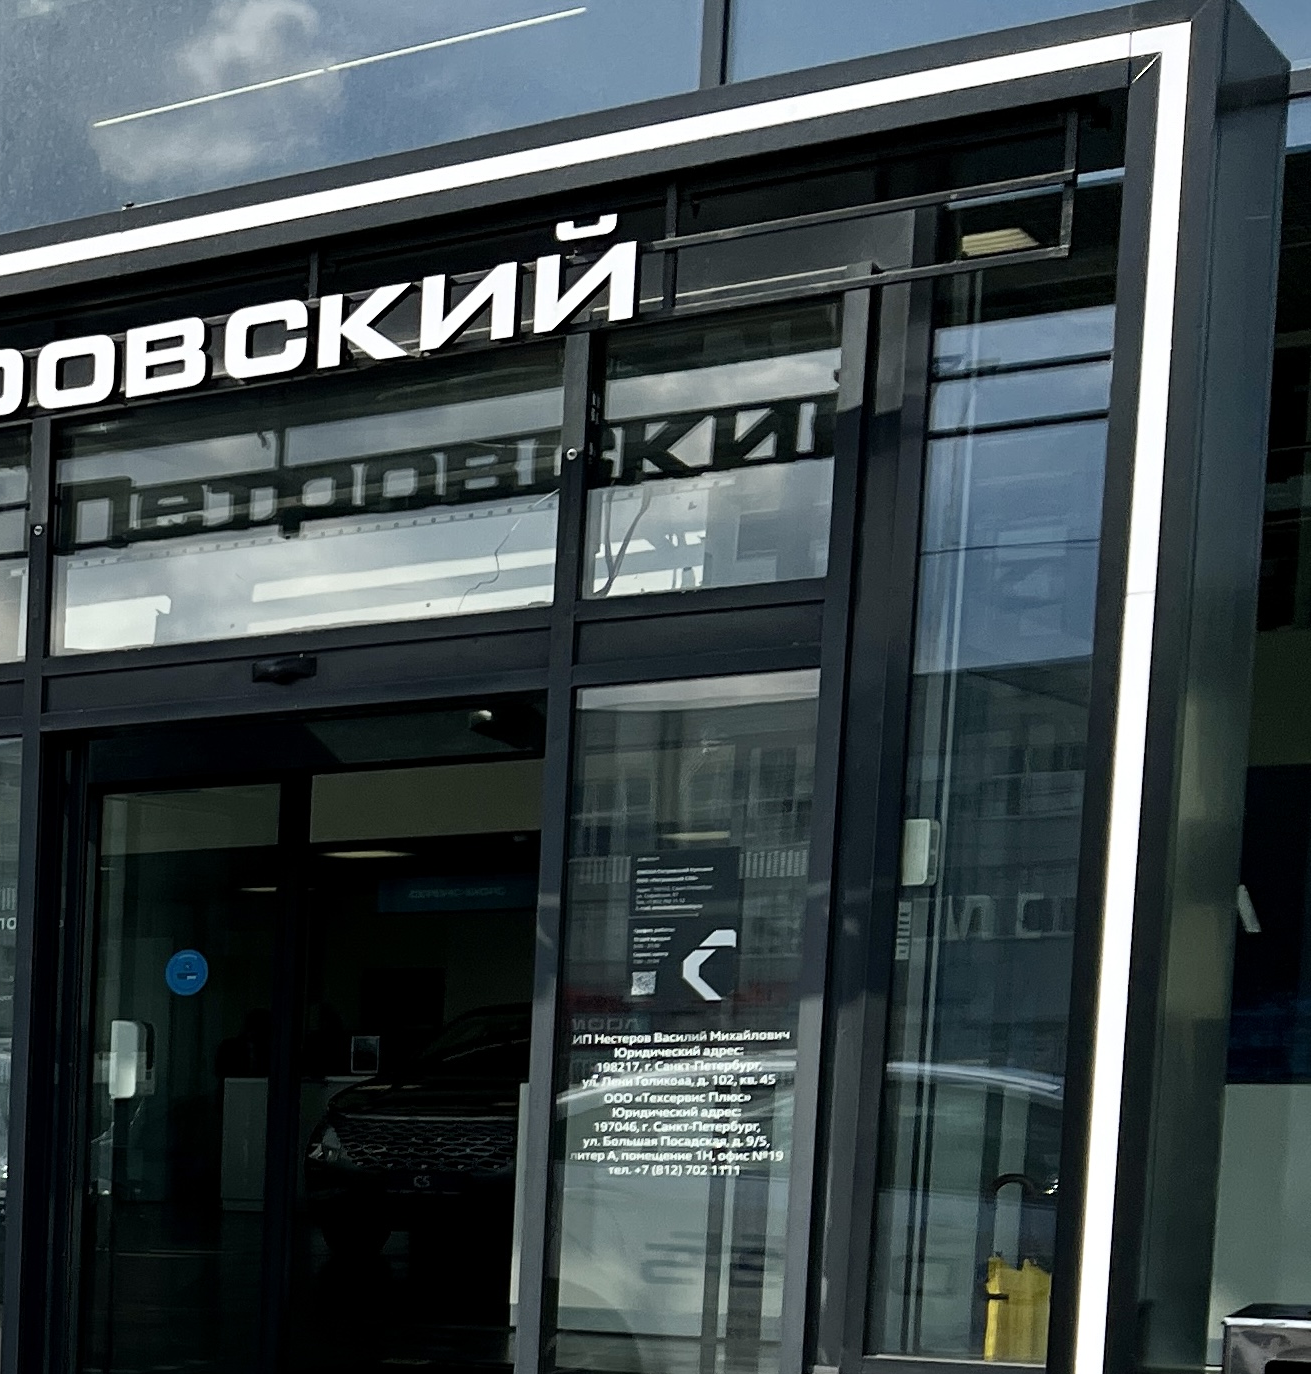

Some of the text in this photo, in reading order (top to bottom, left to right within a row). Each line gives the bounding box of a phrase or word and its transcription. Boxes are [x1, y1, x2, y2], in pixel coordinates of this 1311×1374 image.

[572, 1029, 791, 1046] ИП Нестеров Василий Михайлович
[614, 1046, 745, 1059] Юридический адрес:
[596, 1061, 643, 1073] 198217,
[654, 1059, 763, 1073] Санкт-Петербург,
[711, 1074, 738, 1087] 102,
[759, 1073, 777, 1085] 45
[603, 1093, 633, 1104] ООО
[635, 1092, 706, 1105] «Техсервис
[611, 1107, 742, 1120] Юридический адрес:
[594, 1121, 640, 1133] 197046,
[653, 1120, 761, 1134] Санкт-Петербург,
[582, 1138, 601, 1149] ул.
[602, 1135, 658, 1147] Большая
[745, 1135, 771, 1149] 9/5,
[569, 1151, 606, 1163] литер
[621, 1151, 693, 1163] помещение
[717, 1150, 750, 1163] офис
[608, 1165, 633, 1176] тел.
[634, 1165, 649, 1176] +7
[651, 1164, 683, 1176] (812)
[685, 1164, 708, 1176] 702
